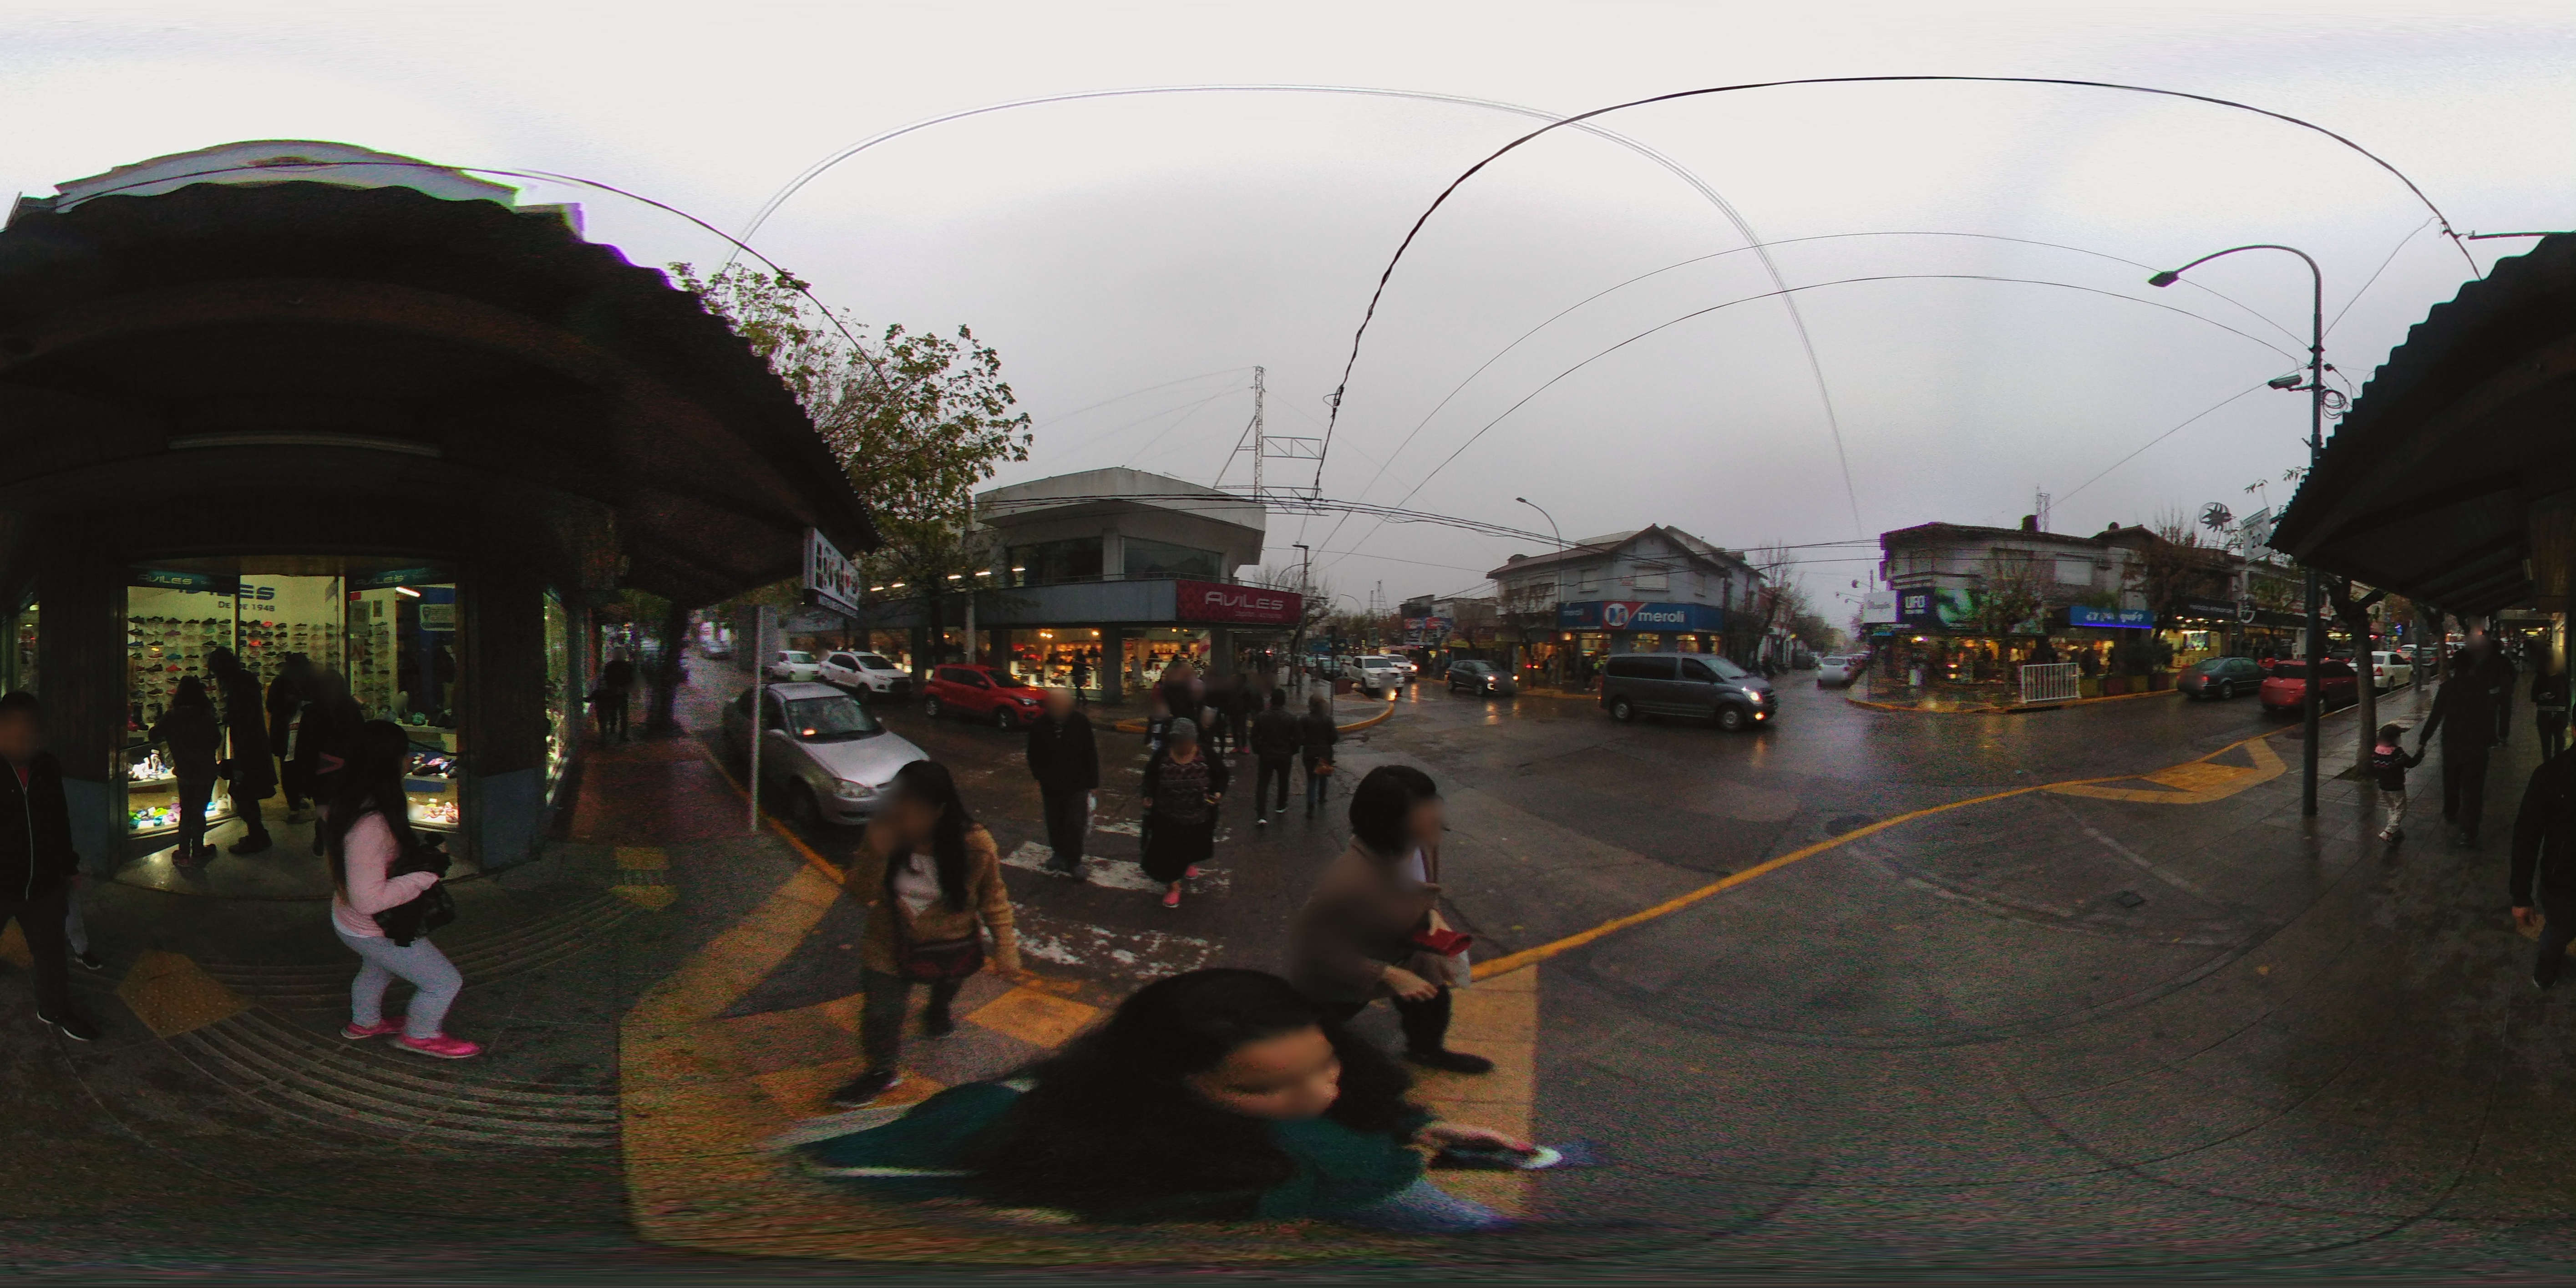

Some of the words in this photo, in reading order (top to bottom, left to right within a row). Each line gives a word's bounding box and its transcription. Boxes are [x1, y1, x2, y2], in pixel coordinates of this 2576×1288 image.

[138, 574, 193, 585] AVILES
[1205, 591, 1284, 610] AVILES
[1905, 596, 1925, 608] UFO
[1638, 610, 1684, 623] meroli
